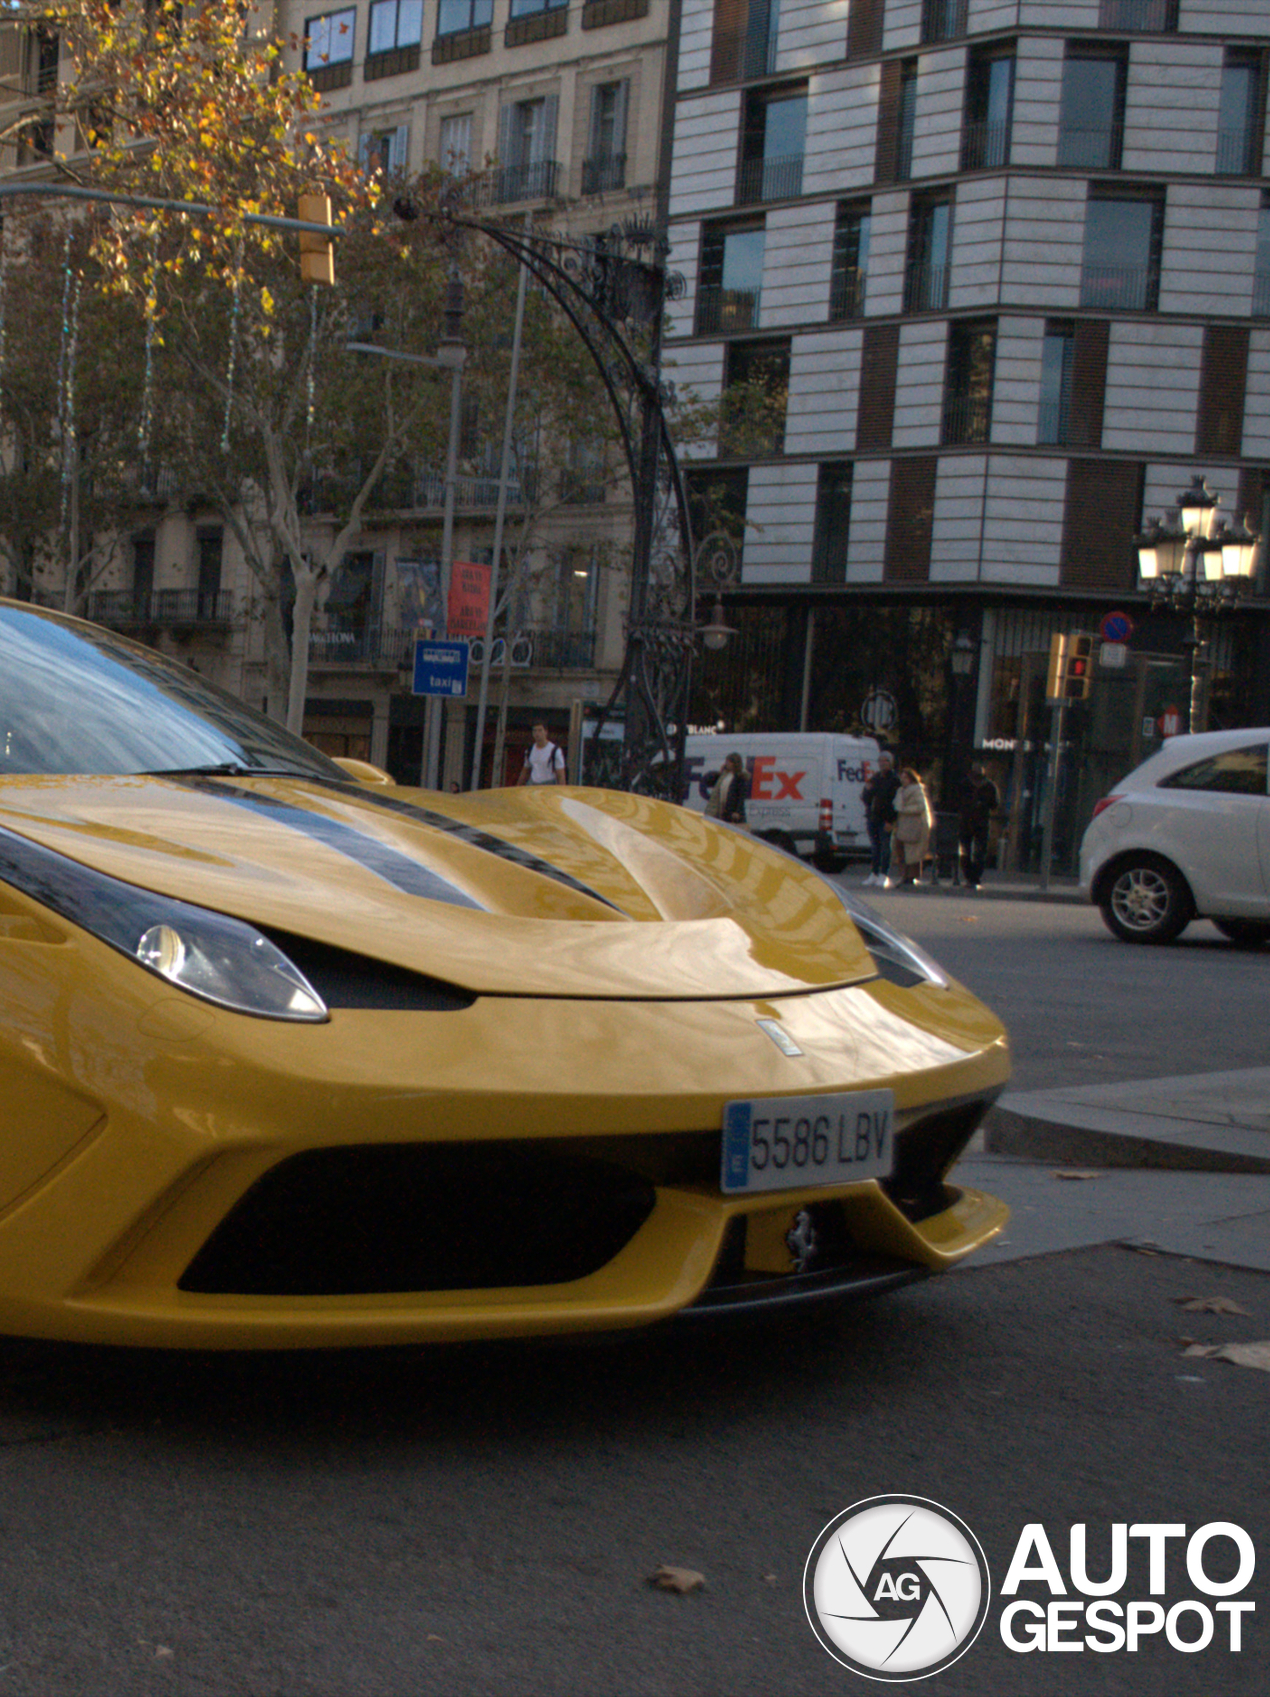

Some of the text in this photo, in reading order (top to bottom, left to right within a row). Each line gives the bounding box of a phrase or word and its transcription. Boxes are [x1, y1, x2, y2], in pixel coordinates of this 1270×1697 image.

[430, 675, 451, 688] taxi
[1163, 714, 1178, 734] M
[751, 1110, 889, 1171] 5586 LBV
